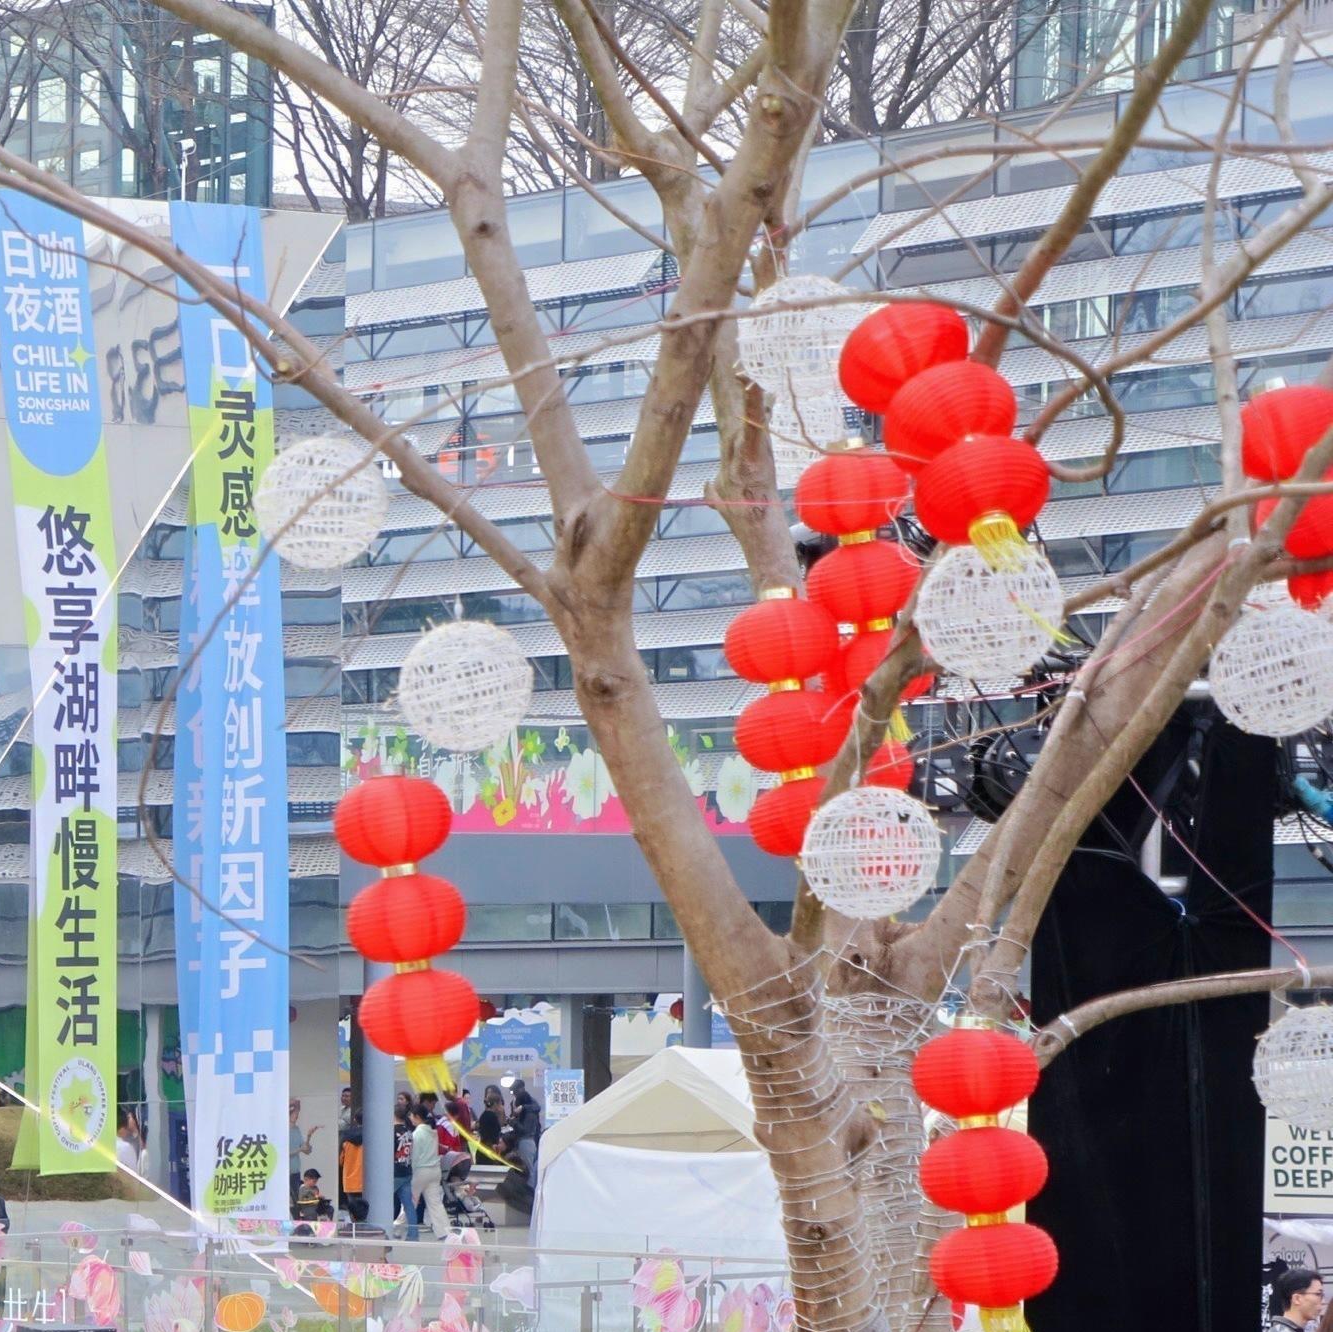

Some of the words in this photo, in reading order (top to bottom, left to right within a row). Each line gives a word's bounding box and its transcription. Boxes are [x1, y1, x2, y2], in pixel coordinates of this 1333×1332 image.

[1, 230, 78, 280] 日咖
[4, 282, 83, 335] 夜酒
[13, 344, 76, 368] CHILL
[15, 370, 61, 393] LIFE
[67, 372, 89, 394] IN
[17, 396, 91, 412] SONGSHAN
[19, 411, 54, 425] LAKE
[37, 504, 100, 1047] 悠享湖畔慢生活
[214, 1170, 268, 1196] 咖啡节
